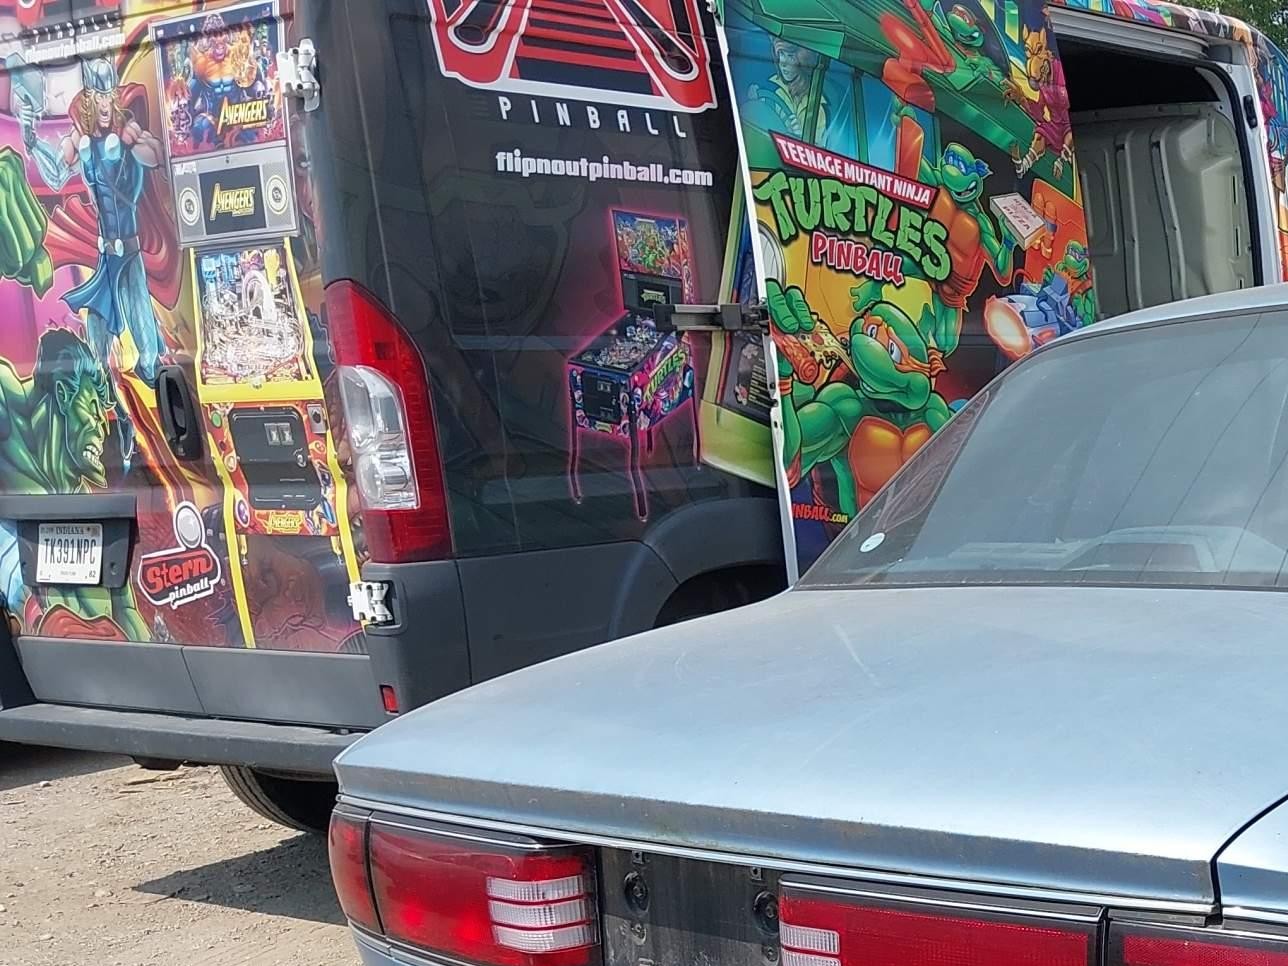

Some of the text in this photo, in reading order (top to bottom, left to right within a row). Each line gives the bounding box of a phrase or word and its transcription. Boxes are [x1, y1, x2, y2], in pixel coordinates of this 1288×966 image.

[498, 96, 687, 138] PINBALL
[495, 148, 713, 187] flipnoutpinball.com
[776, 138, 932, 205] TEENAGE MUTANT NINJA
[753, 171, 951, 281] TURTLES
[811, 231, 905, 286] PINBALL
[44, 537, 97, 565] TK391NPC
[146, 556, 213, 594] Stern
[168, 576, 210, 603] pinball
